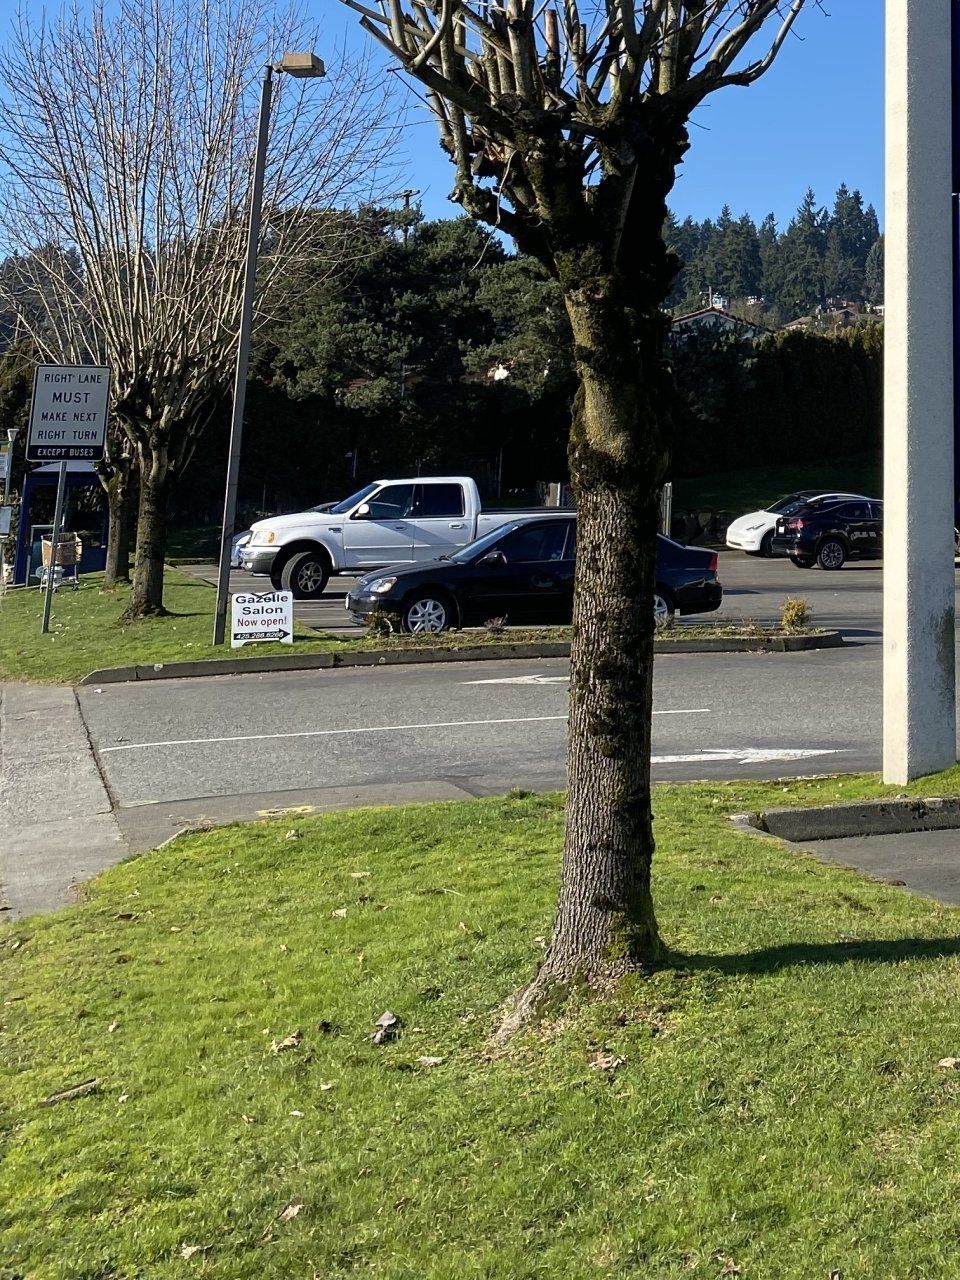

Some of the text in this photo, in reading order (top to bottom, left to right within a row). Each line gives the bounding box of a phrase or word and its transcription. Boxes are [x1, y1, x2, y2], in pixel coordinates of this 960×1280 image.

[44, 373, 102, 384] RIGHT LANE
[52, 391, 91, 404] MUST
[41, 412, 98, 422] MAKE NEXT
[37, 430, 98, 440] RIGHT TURN
[37, 448, 94, 457] EXCEPT BUSES
[235, 593, 289, 604] Gazelle
[242, 606, 283, 616] Salon
[237, 616, 287, 627] Now open!
